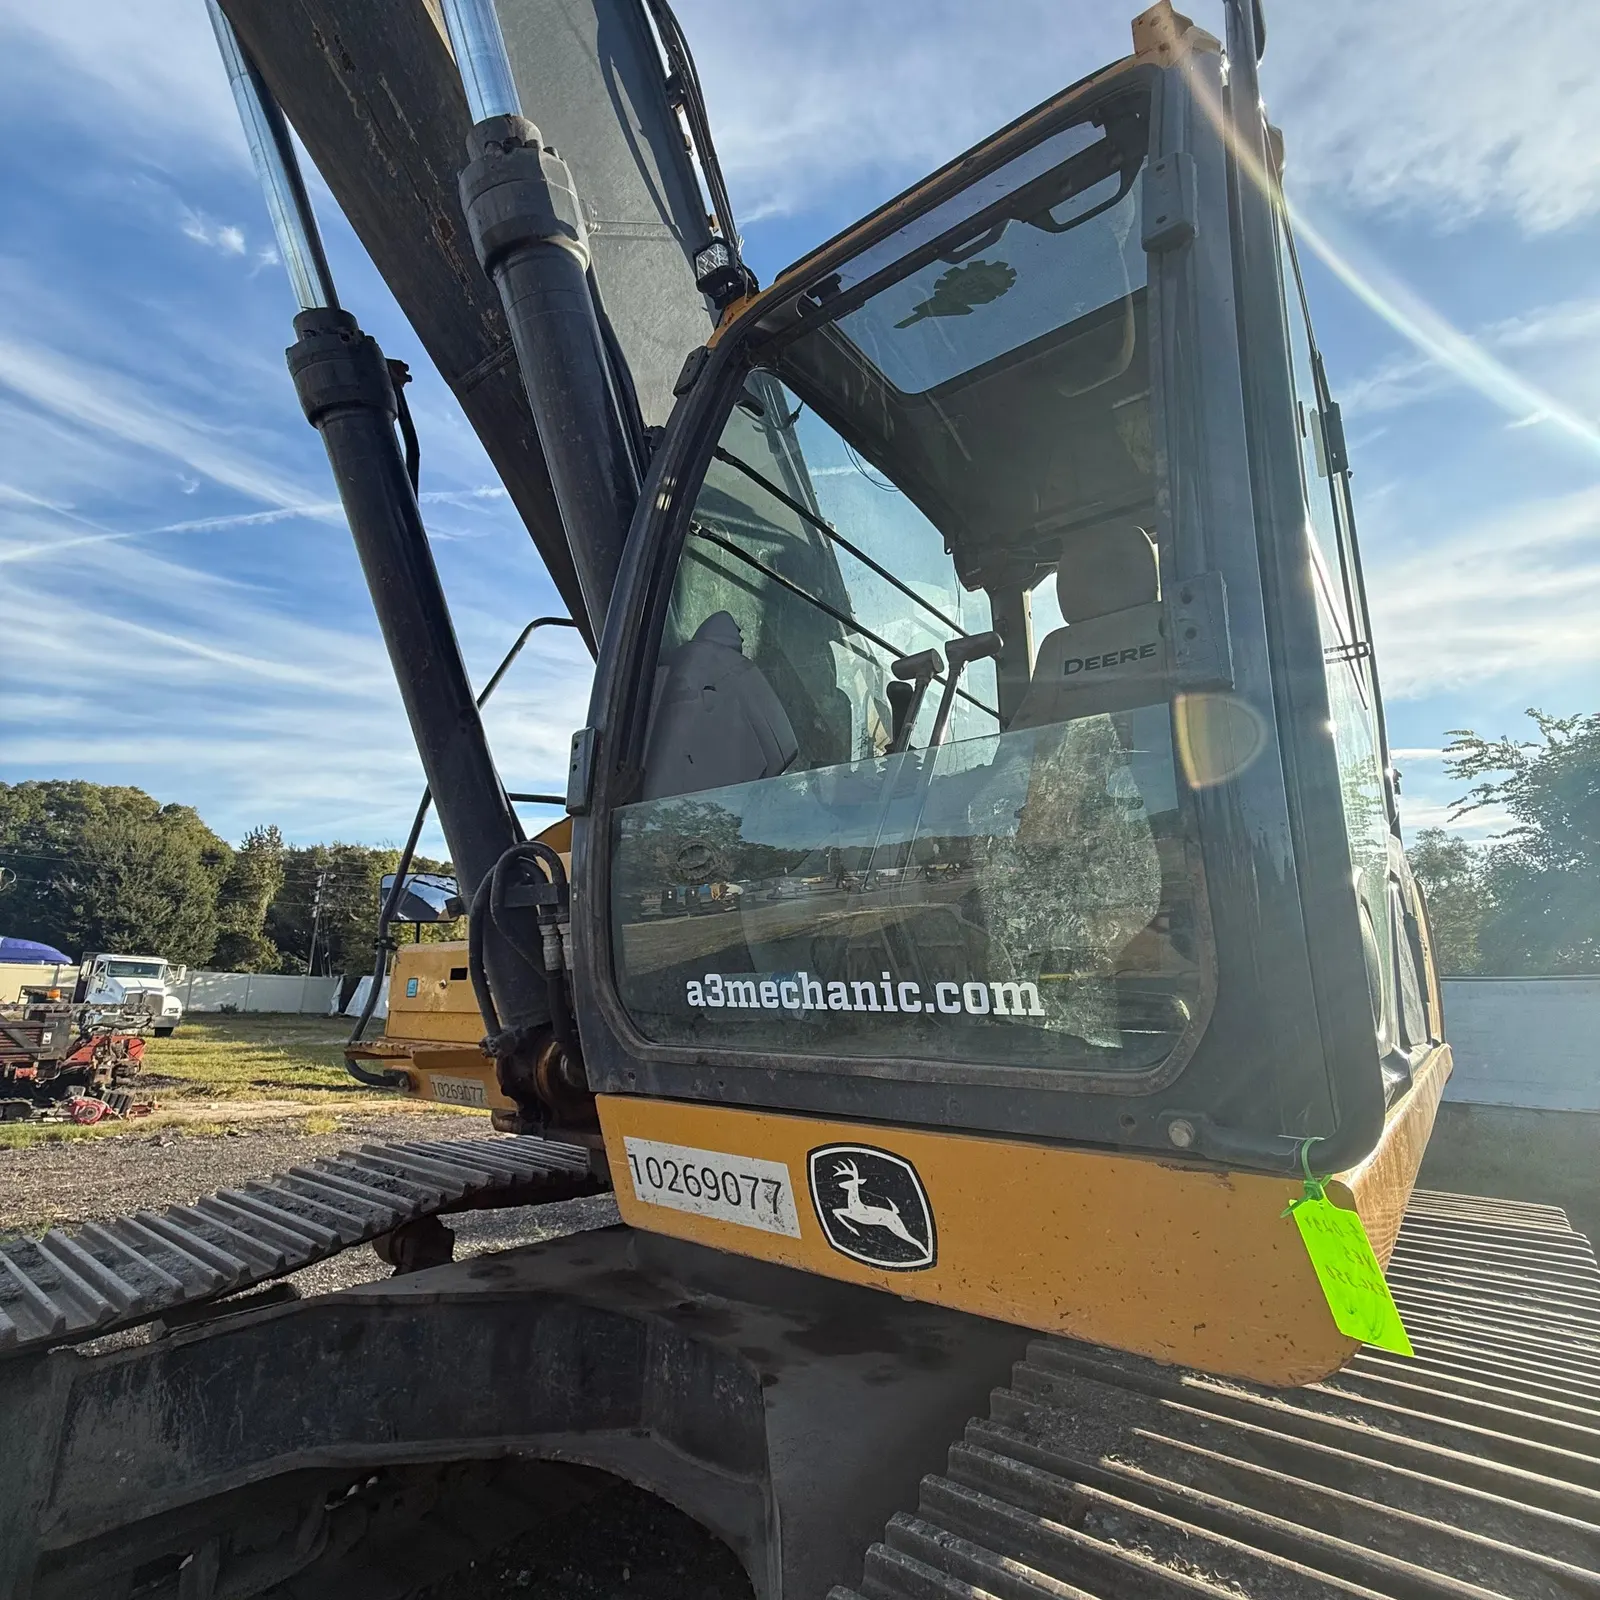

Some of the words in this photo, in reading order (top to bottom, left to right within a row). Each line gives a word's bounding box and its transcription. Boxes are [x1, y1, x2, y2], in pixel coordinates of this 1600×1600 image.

[1064, 643, 1157, 676] DEERE
[686, 971, 1045, 1017] a3mechanic.com
[431, 1081, 484, 1103] 10269077
[627, 1153, 782, 1215] 10269077
